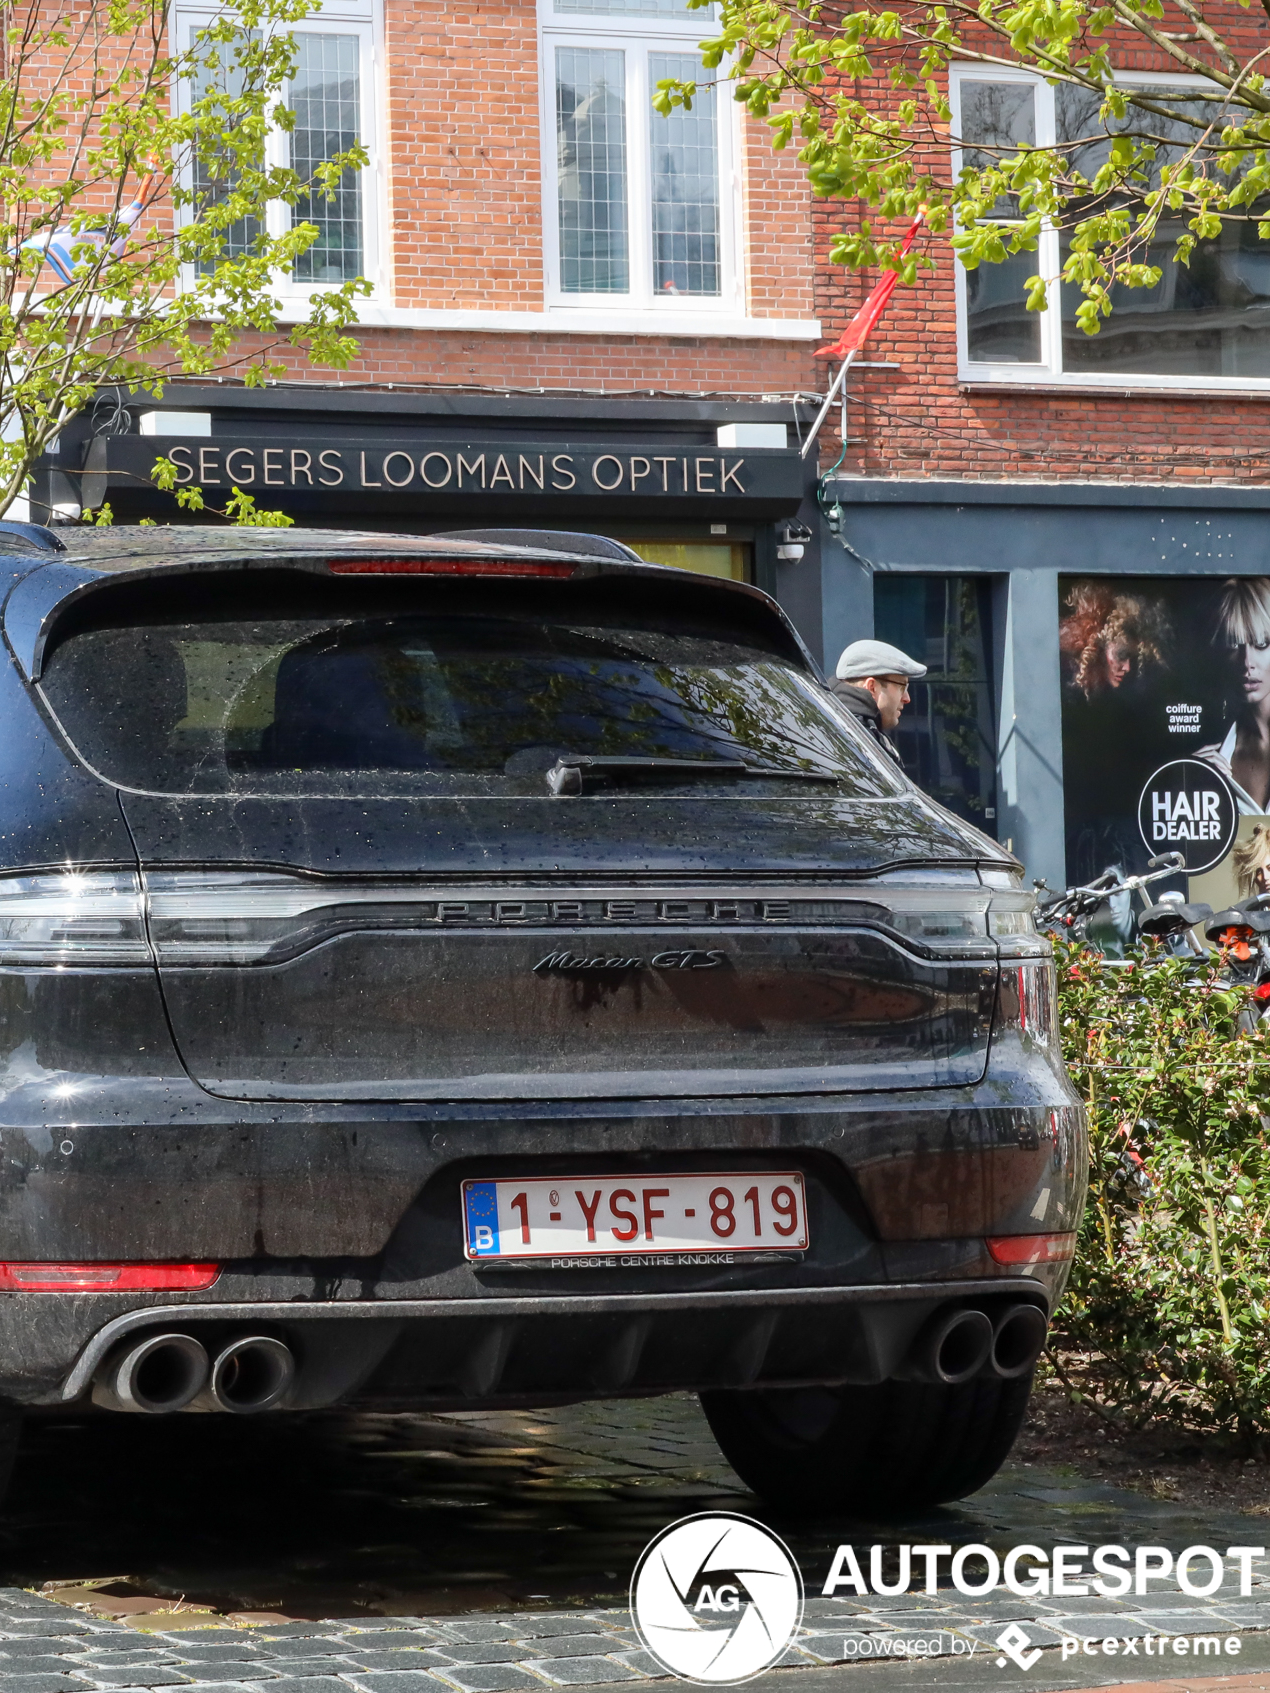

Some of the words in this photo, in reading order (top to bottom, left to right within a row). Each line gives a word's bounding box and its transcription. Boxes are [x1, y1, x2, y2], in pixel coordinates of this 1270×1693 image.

[168, 447, 344, 486] SEGERS
[361, 451, 576, 490] LOOMANS
[592, 455, 745, 493] OPTIEK
[1165, 703, 1203, 714] coiffure
[1169, 714, 1199, 723] award
[1168, 724, 1201, 733] winner
[1152, 791, 1220, 821] HAIR
[1153, 821, 1221, 840] DEALER
[436, 901, 791, 921] PORSCHE
[532, 950, 644, 971] Macan
[651, 950, 725, 969] GTS
[475, 1226, 494, 1250] B
[551, 1256, 616, 1268] PORSCHE
[620, 1255, 674, 1267] CENTRE
[678, 1253, 734, 1265] KNOKKE
